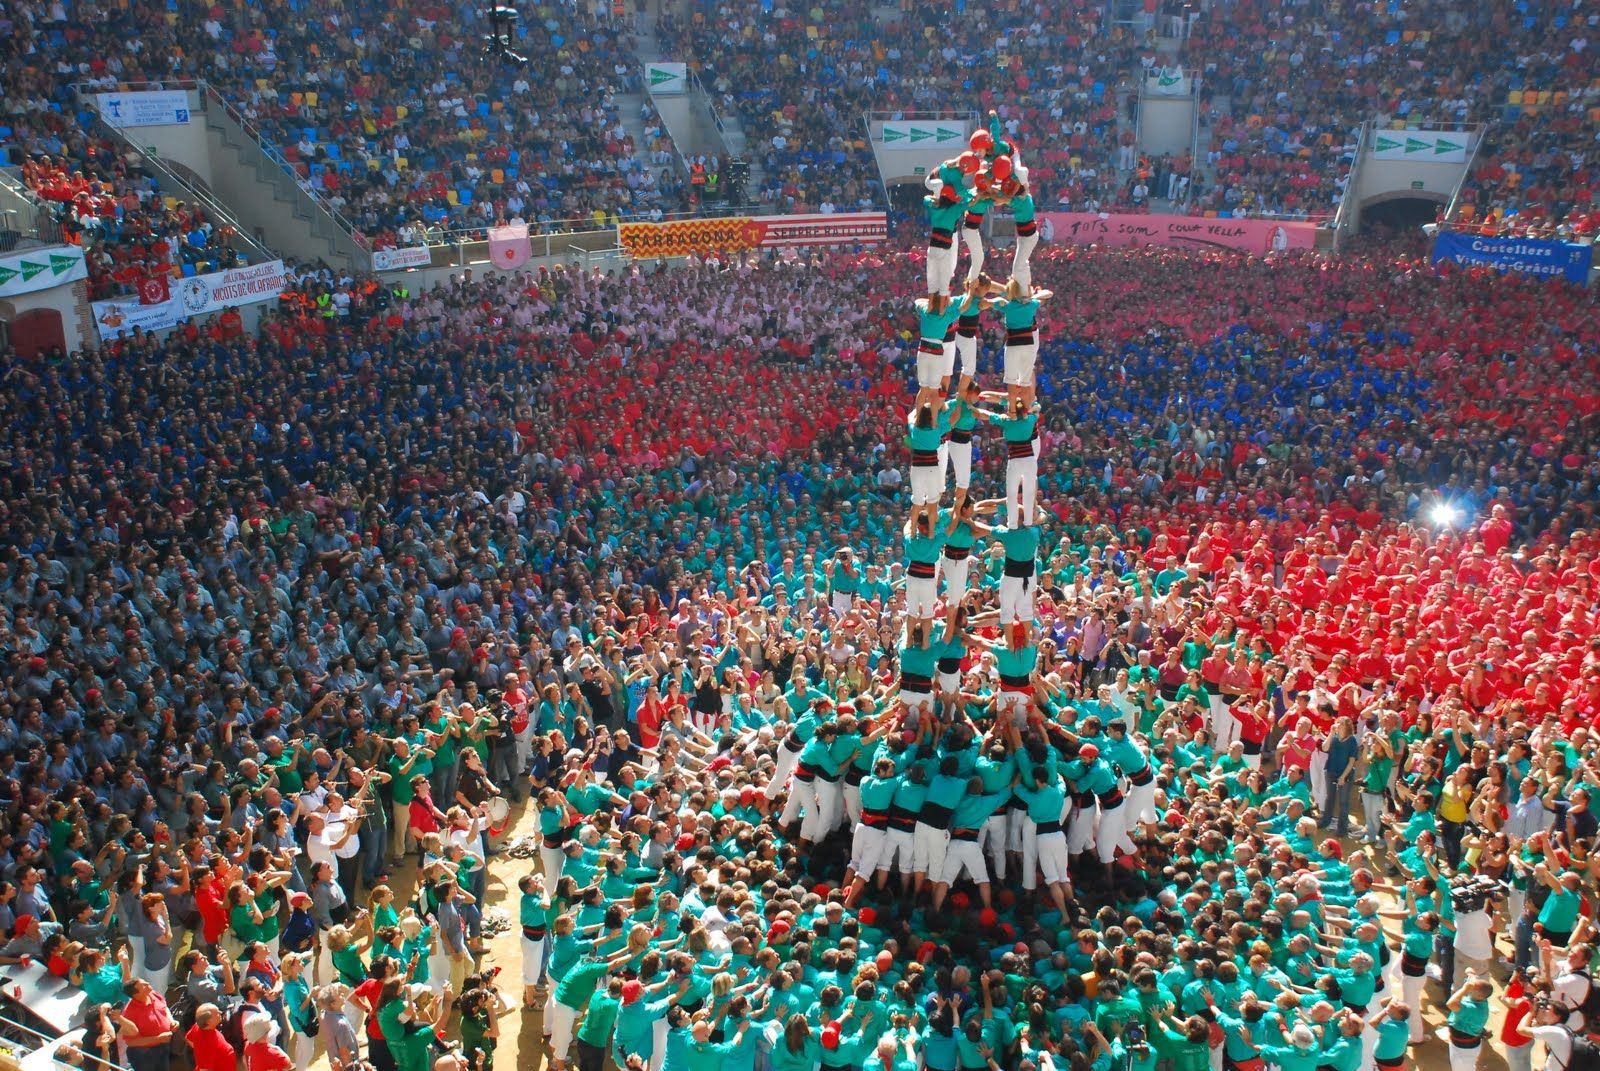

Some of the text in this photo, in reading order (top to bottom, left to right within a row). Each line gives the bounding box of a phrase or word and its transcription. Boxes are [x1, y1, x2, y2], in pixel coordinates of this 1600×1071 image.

[773, 226, 819, 239] SEMPRE
[1070, 220, 1109, 235] TOTS
[1207, 224, 1247, 236] VELLA
[626, 226, 737, 248] TARRAGONA
[1472, 240, 1552, 257] Castellers
